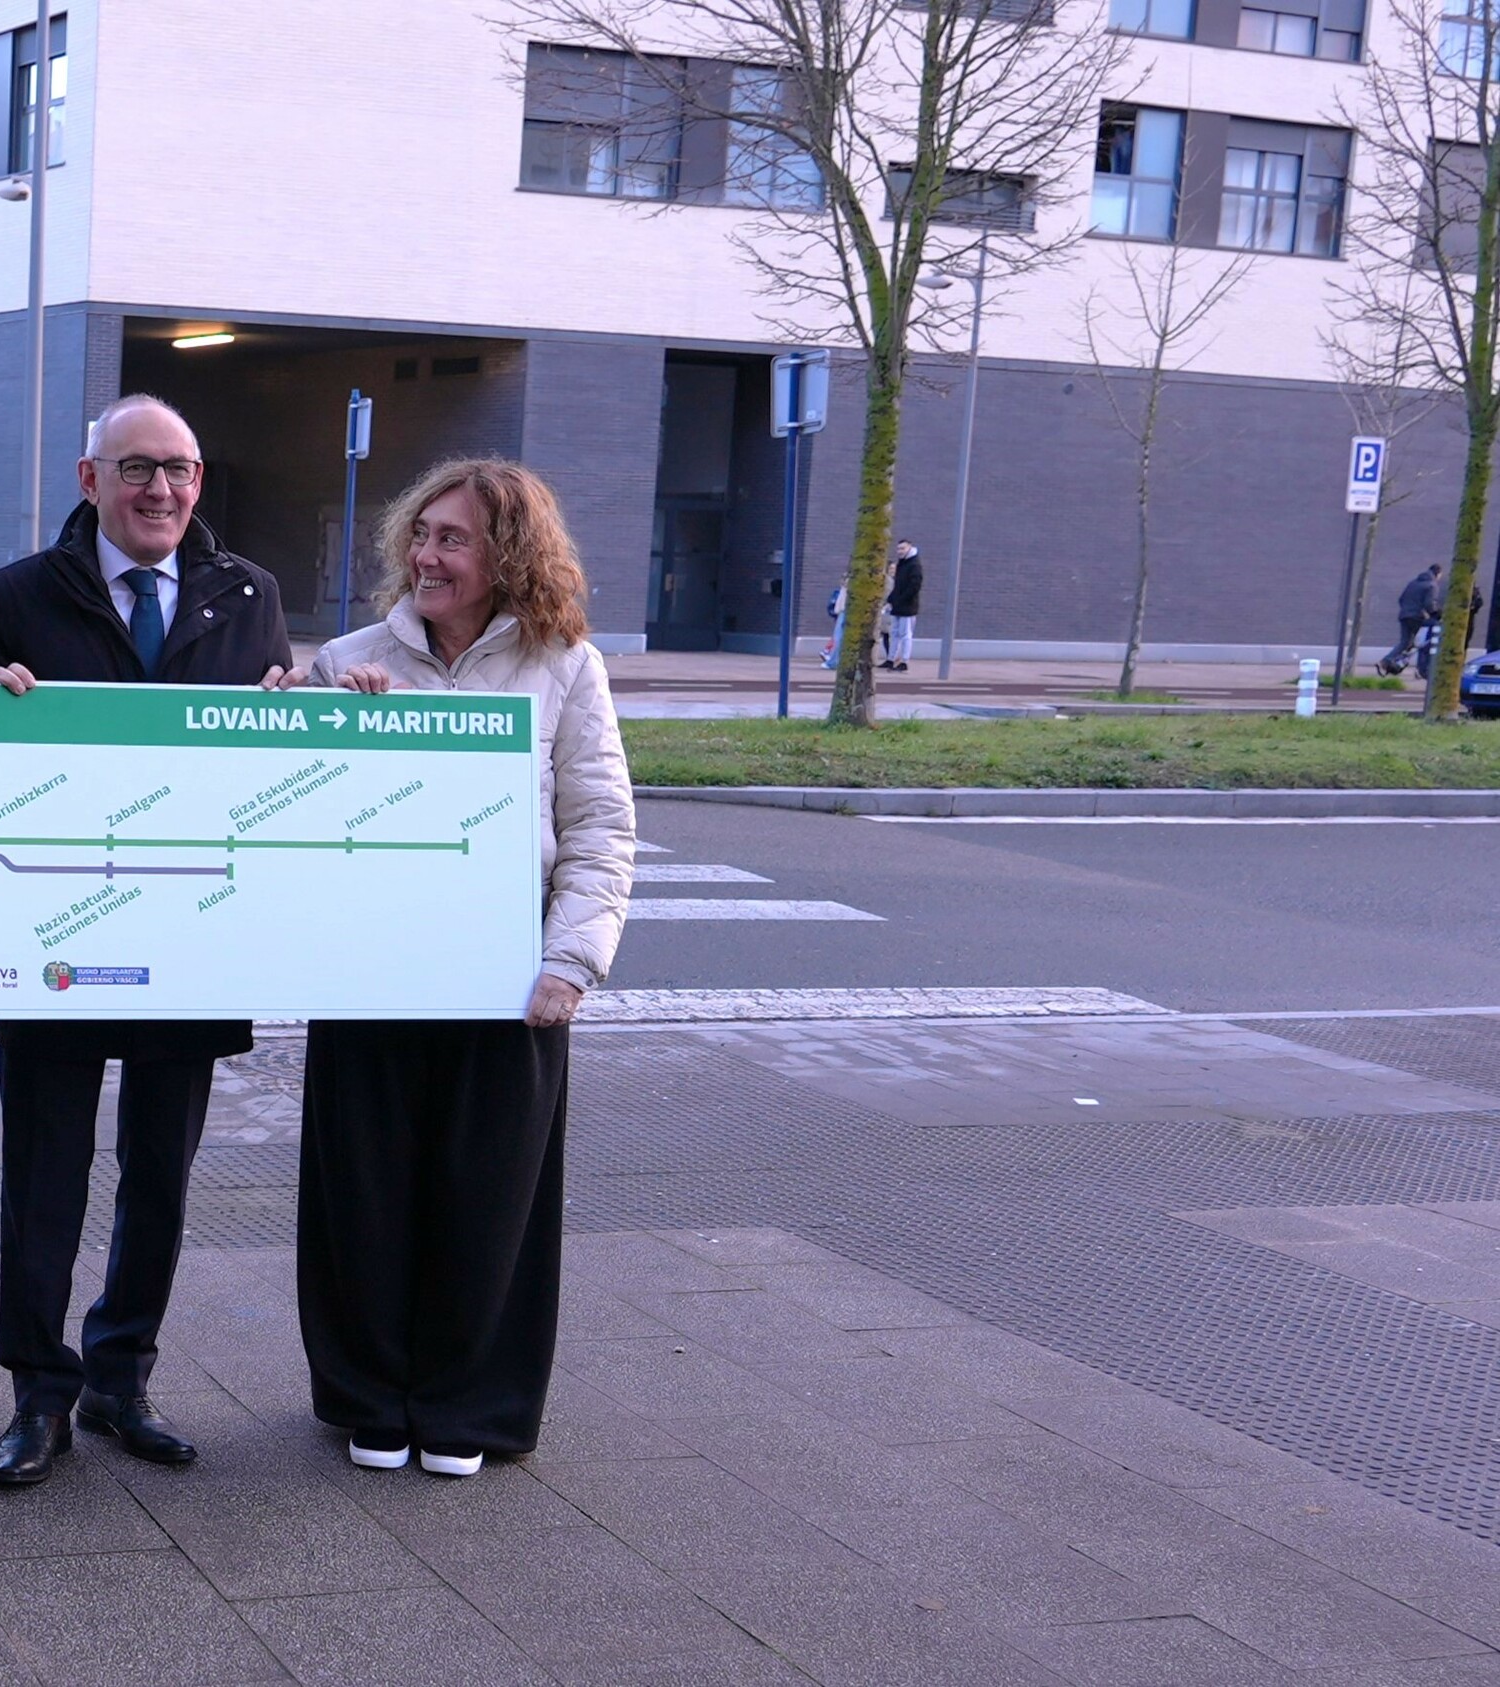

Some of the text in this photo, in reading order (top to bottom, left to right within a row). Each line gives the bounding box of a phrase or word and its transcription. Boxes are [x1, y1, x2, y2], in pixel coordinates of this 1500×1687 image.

[185, 706, 514, 736] LOVAINA MARITURRI
[105, 785, 171, 827] Zabalgana
[228, 759, 327, 820] Giza Eskubideak
[236, 762, 350, 833] Derechos Humanos
[345, 808, 378, 830] Iruña
[384, 779, 424, 806] Veleia
[460, 793, 514, 832] Mariturri
[34, 884, 117, 937] Nazio Batuak
[41, 886, 143, 950] Naciones Unidas
[197, 884, 237, 913] Aldaia
